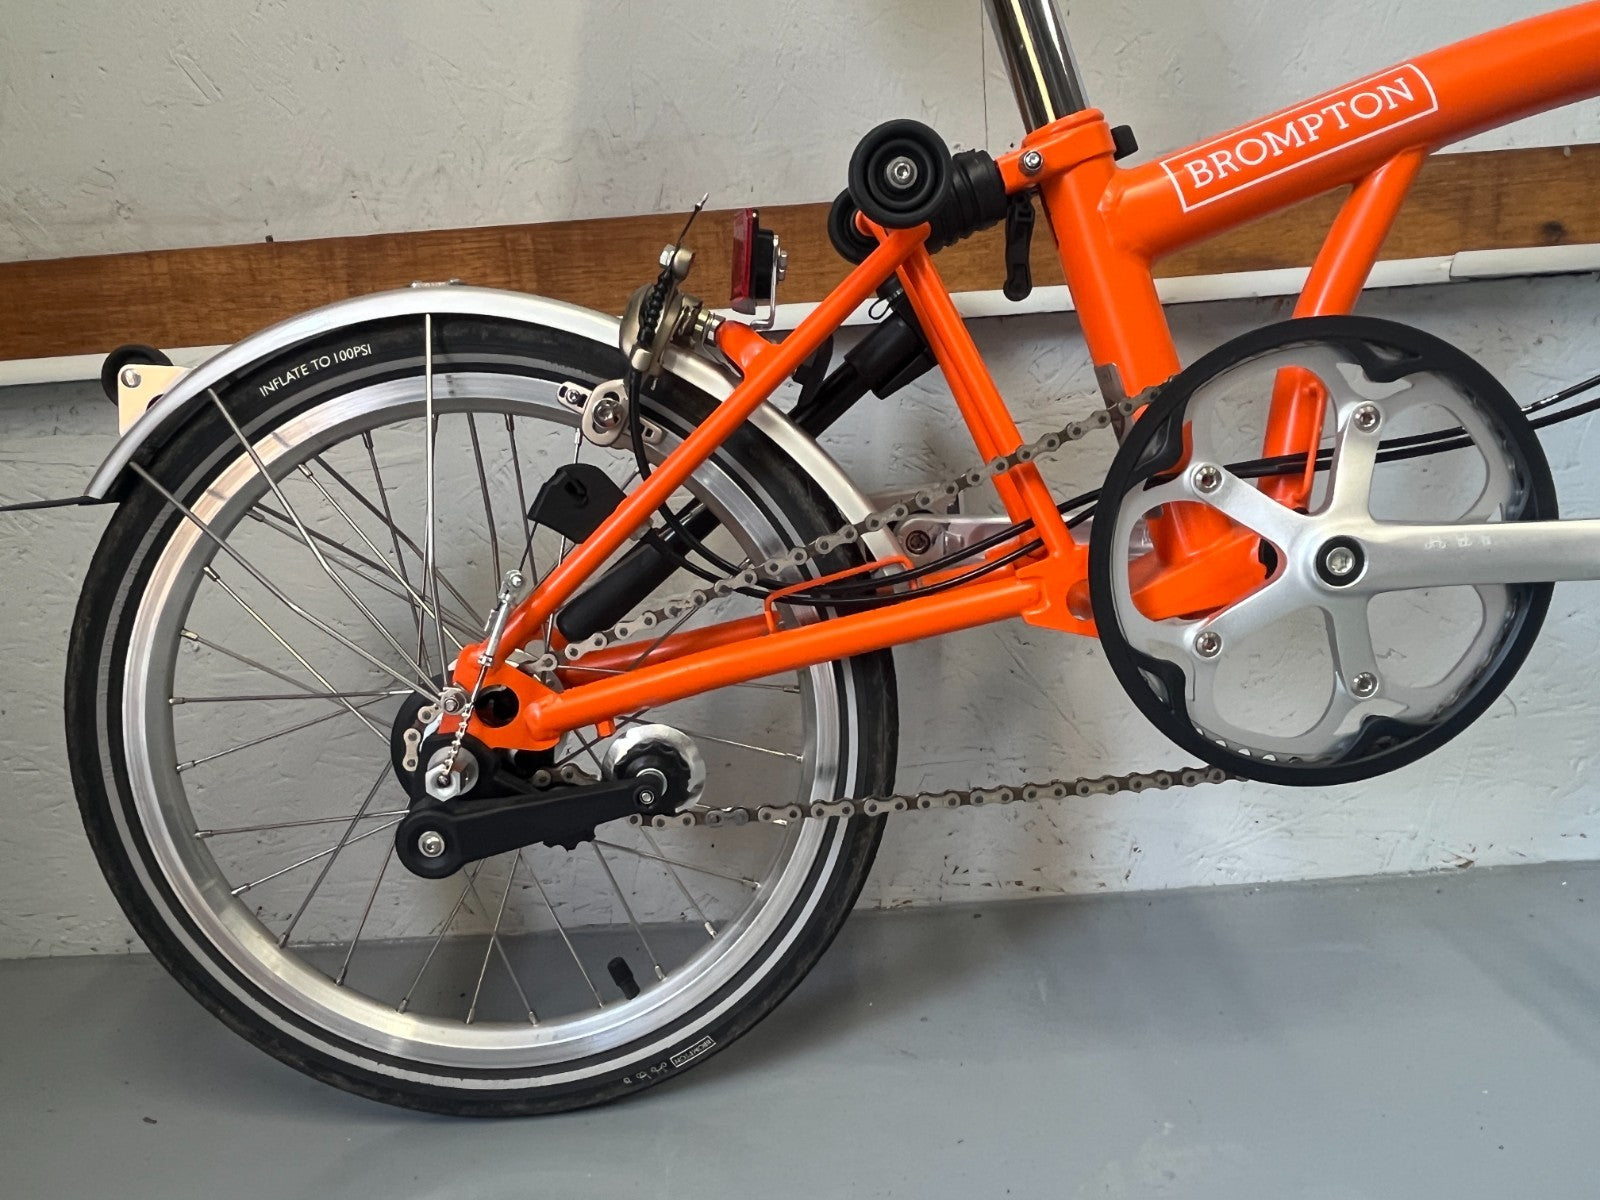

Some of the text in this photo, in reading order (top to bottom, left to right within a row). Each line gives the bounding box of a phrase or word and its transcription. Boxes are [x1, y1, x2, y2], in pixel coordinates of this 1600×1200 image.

[1184, 77, 1415, 189] BROMPTON
[259, 343, 373, 397] INFLATE TO 100PSI
